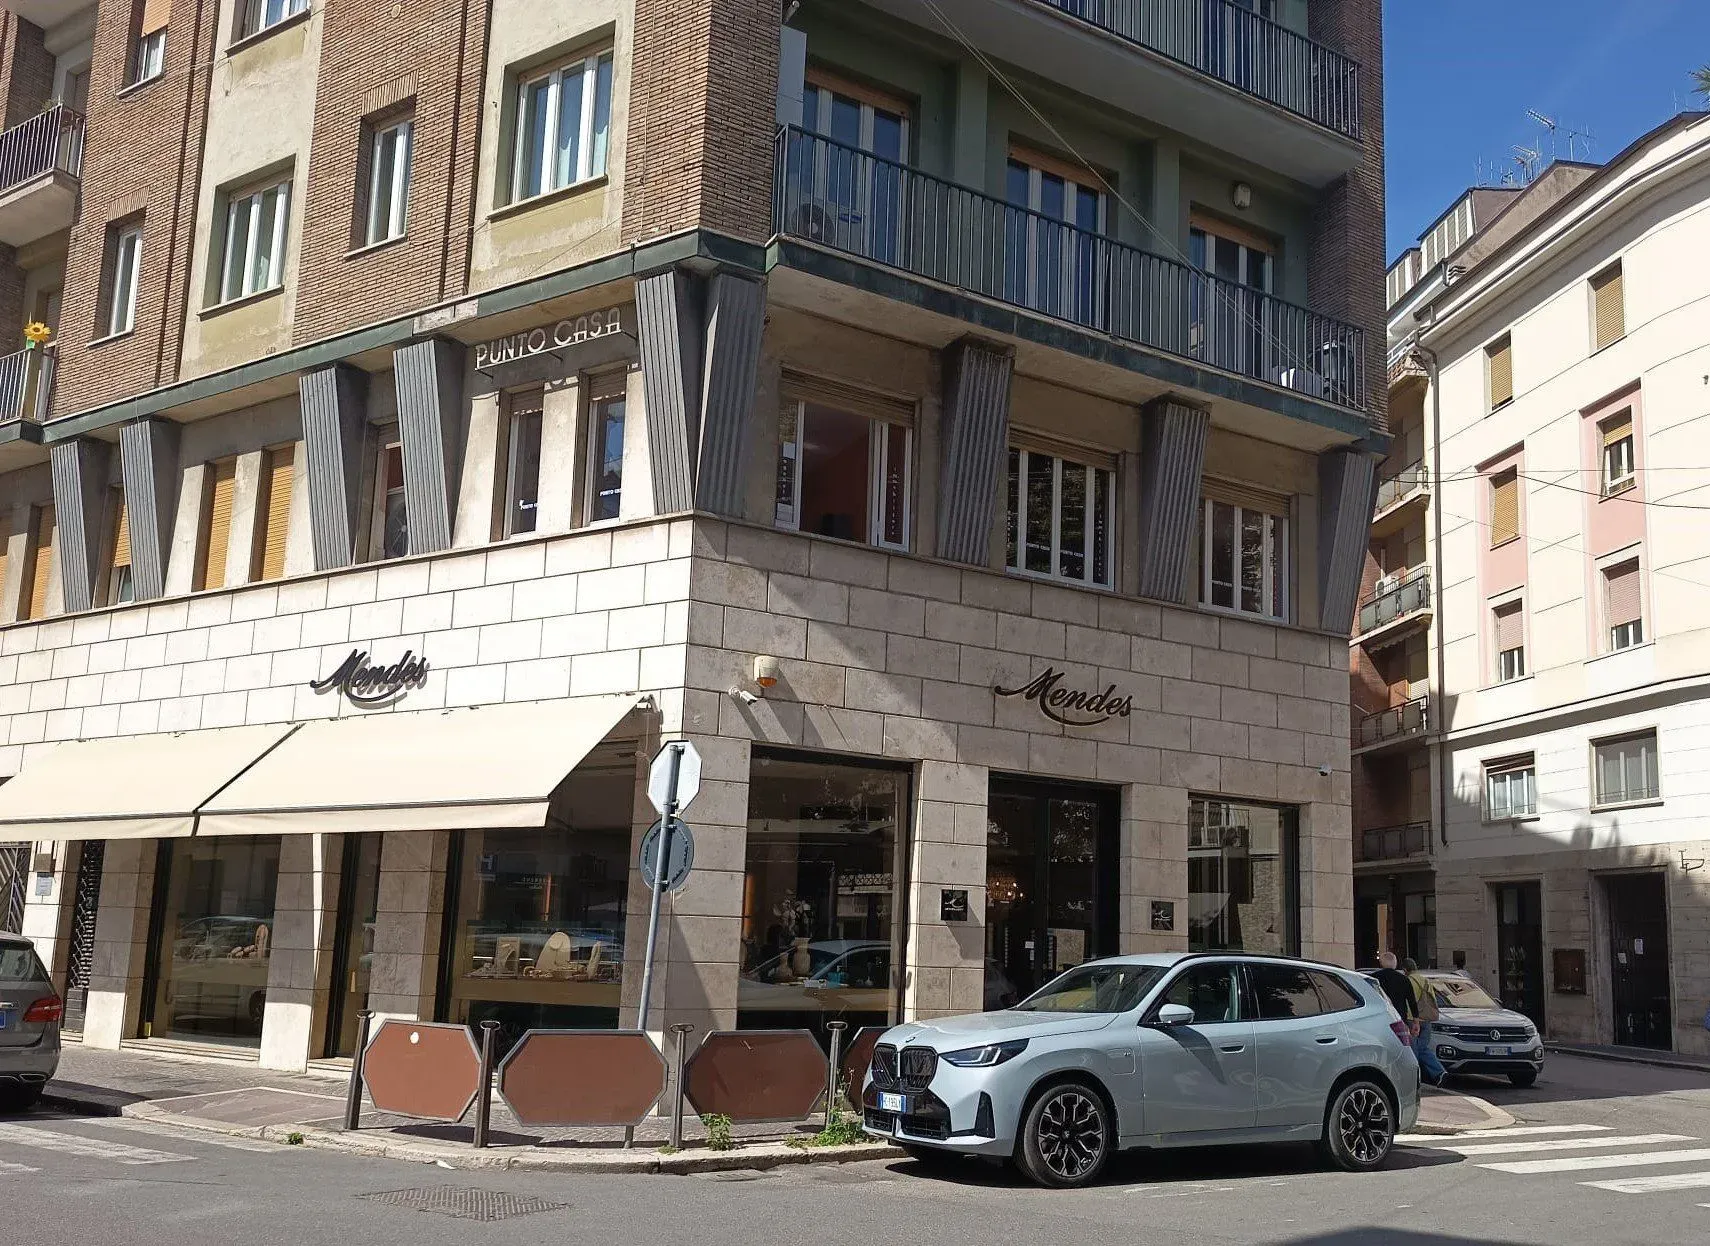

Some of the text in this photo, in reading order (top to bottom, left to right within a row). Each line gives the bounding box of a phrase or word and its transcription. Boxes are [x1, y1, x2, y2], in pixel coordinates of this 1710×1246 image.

[475, 307, 621, 370] PUNTO CASA
[310, 649, 427, 702] Mendes
[994, 667, 1133, 726] Mendes
